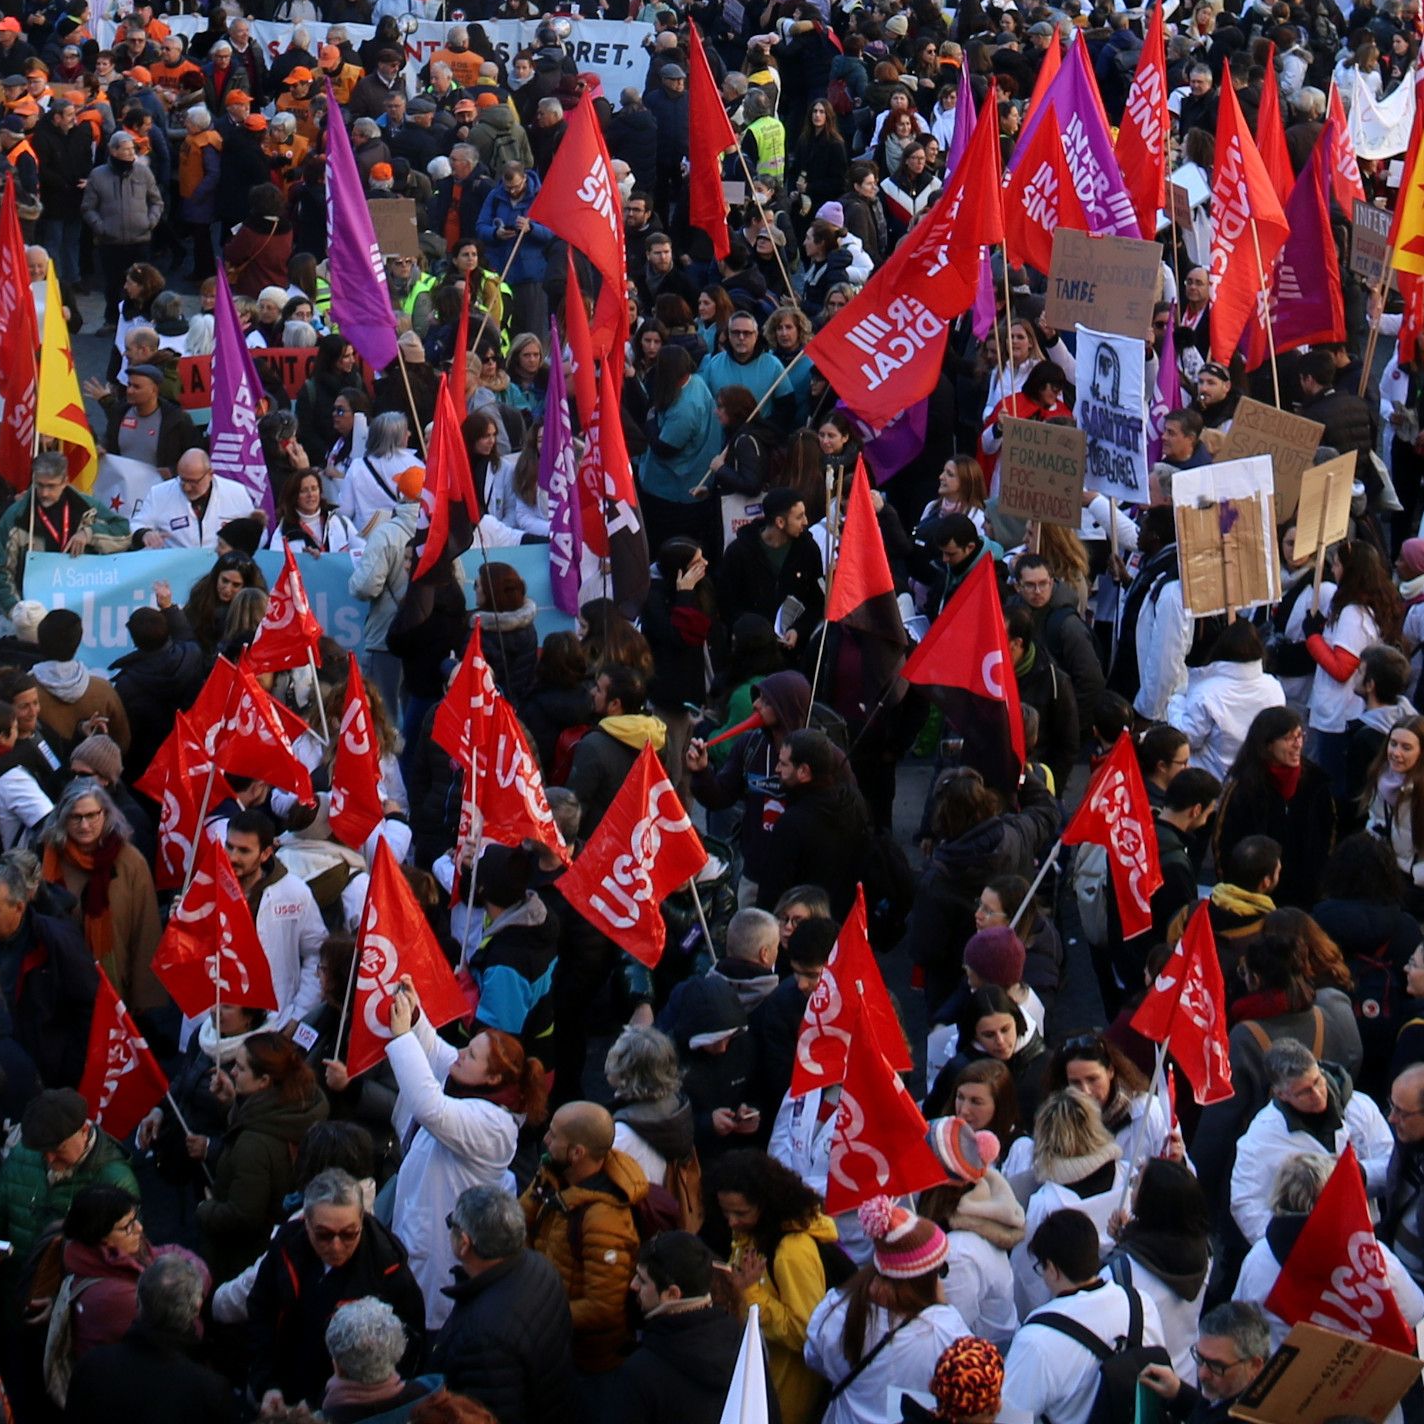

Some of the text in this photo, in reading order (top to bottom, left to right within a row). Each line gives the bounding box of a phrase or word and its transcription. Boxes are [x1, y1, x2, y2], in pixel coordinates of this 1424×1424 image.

[1010, 425, 1053, 446] MOLT
[1010, 446, 1077, 476] FORMADES
[1010, 466, 1036, 488] POC
[66, 567, 119, 586] Sanitat
[589, 778, 692, 929] USOC
